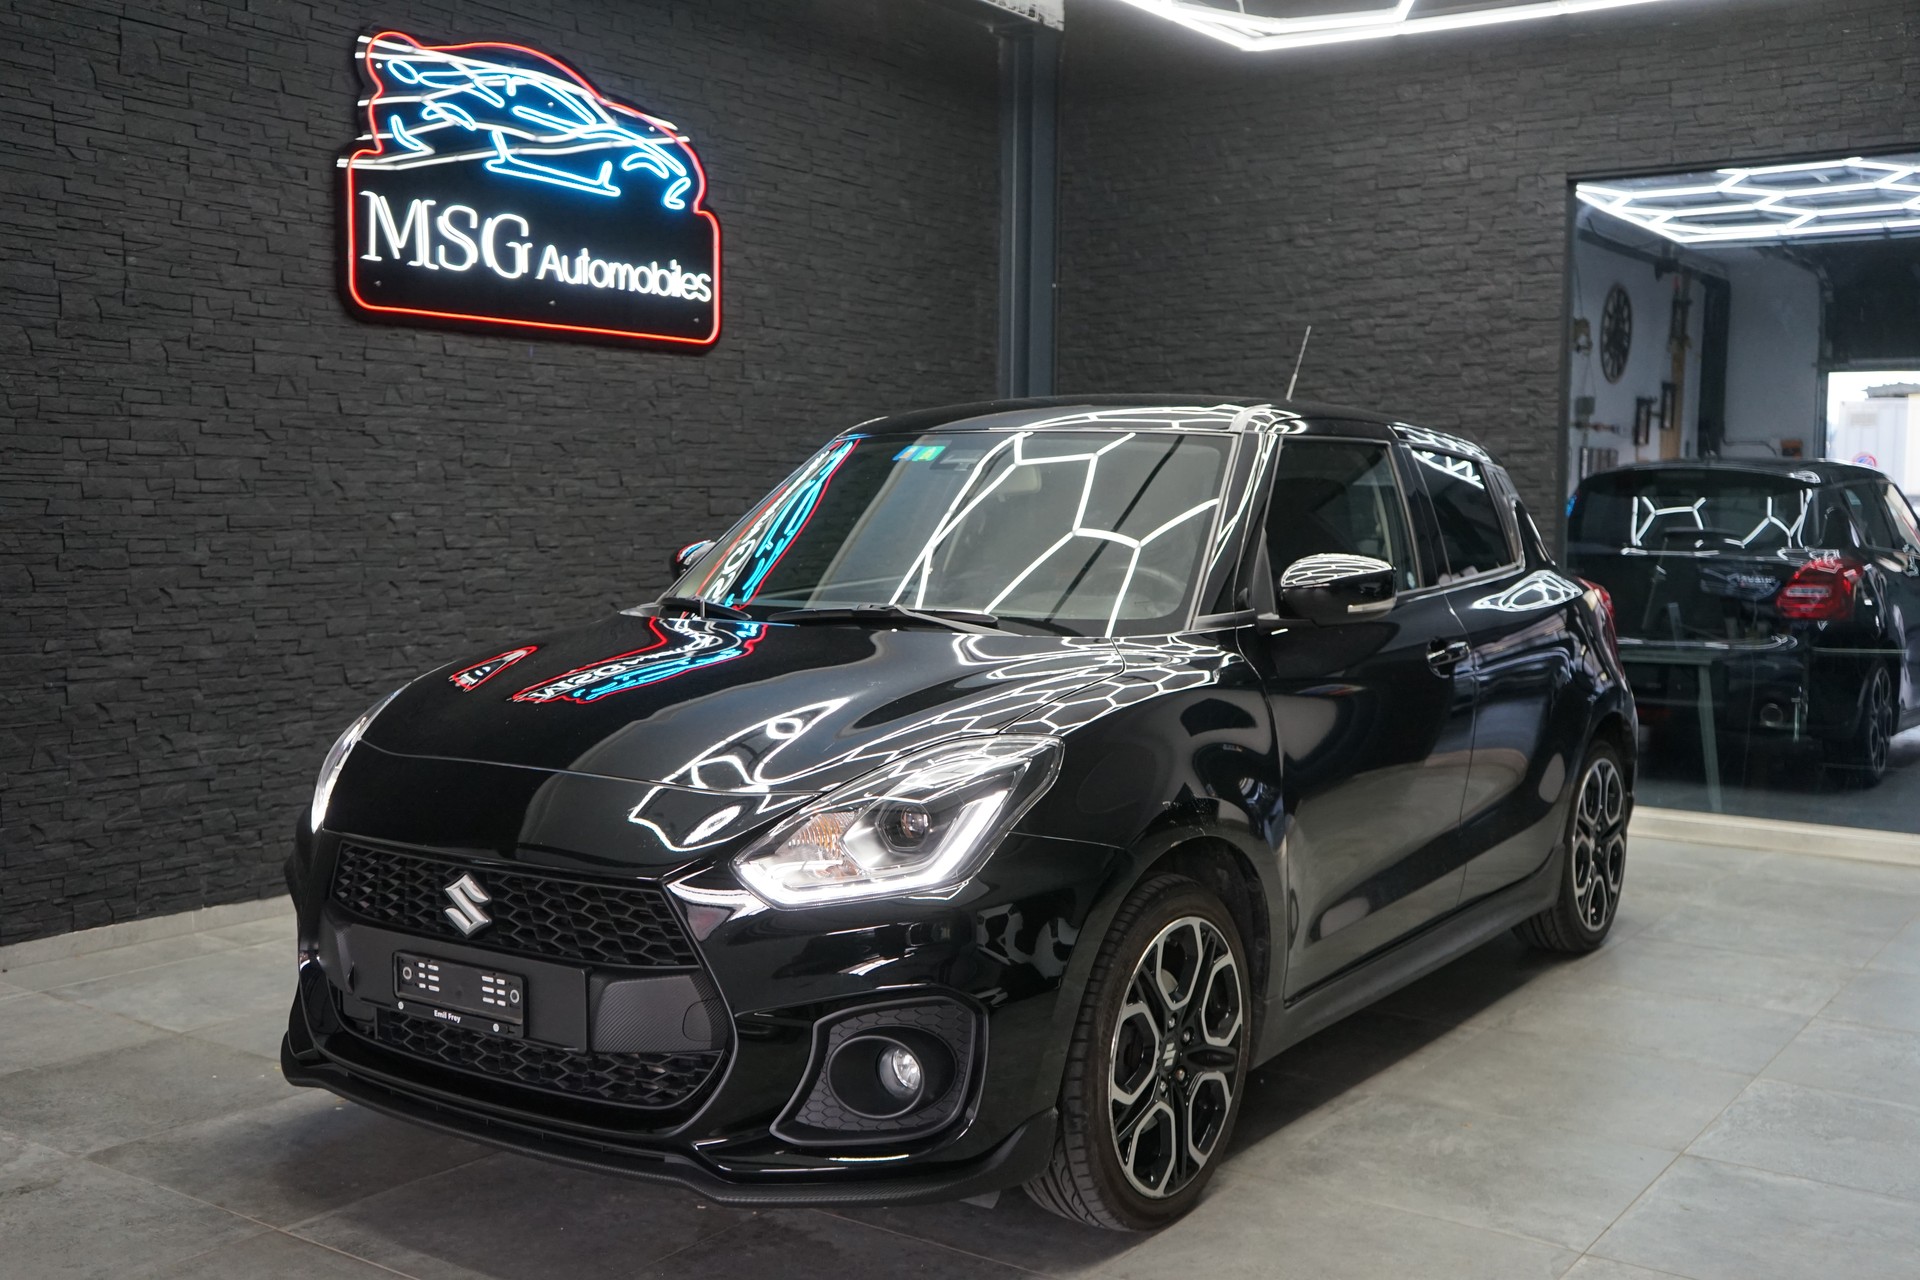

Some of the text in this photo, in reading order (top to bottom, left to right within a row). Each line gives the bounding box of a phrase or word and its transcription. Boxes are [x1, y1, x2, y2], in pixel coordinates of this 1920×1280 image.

[359, 190, 712, 303] MSG Automobiles
[433, 1009, 461, 1024] Emil Frey
